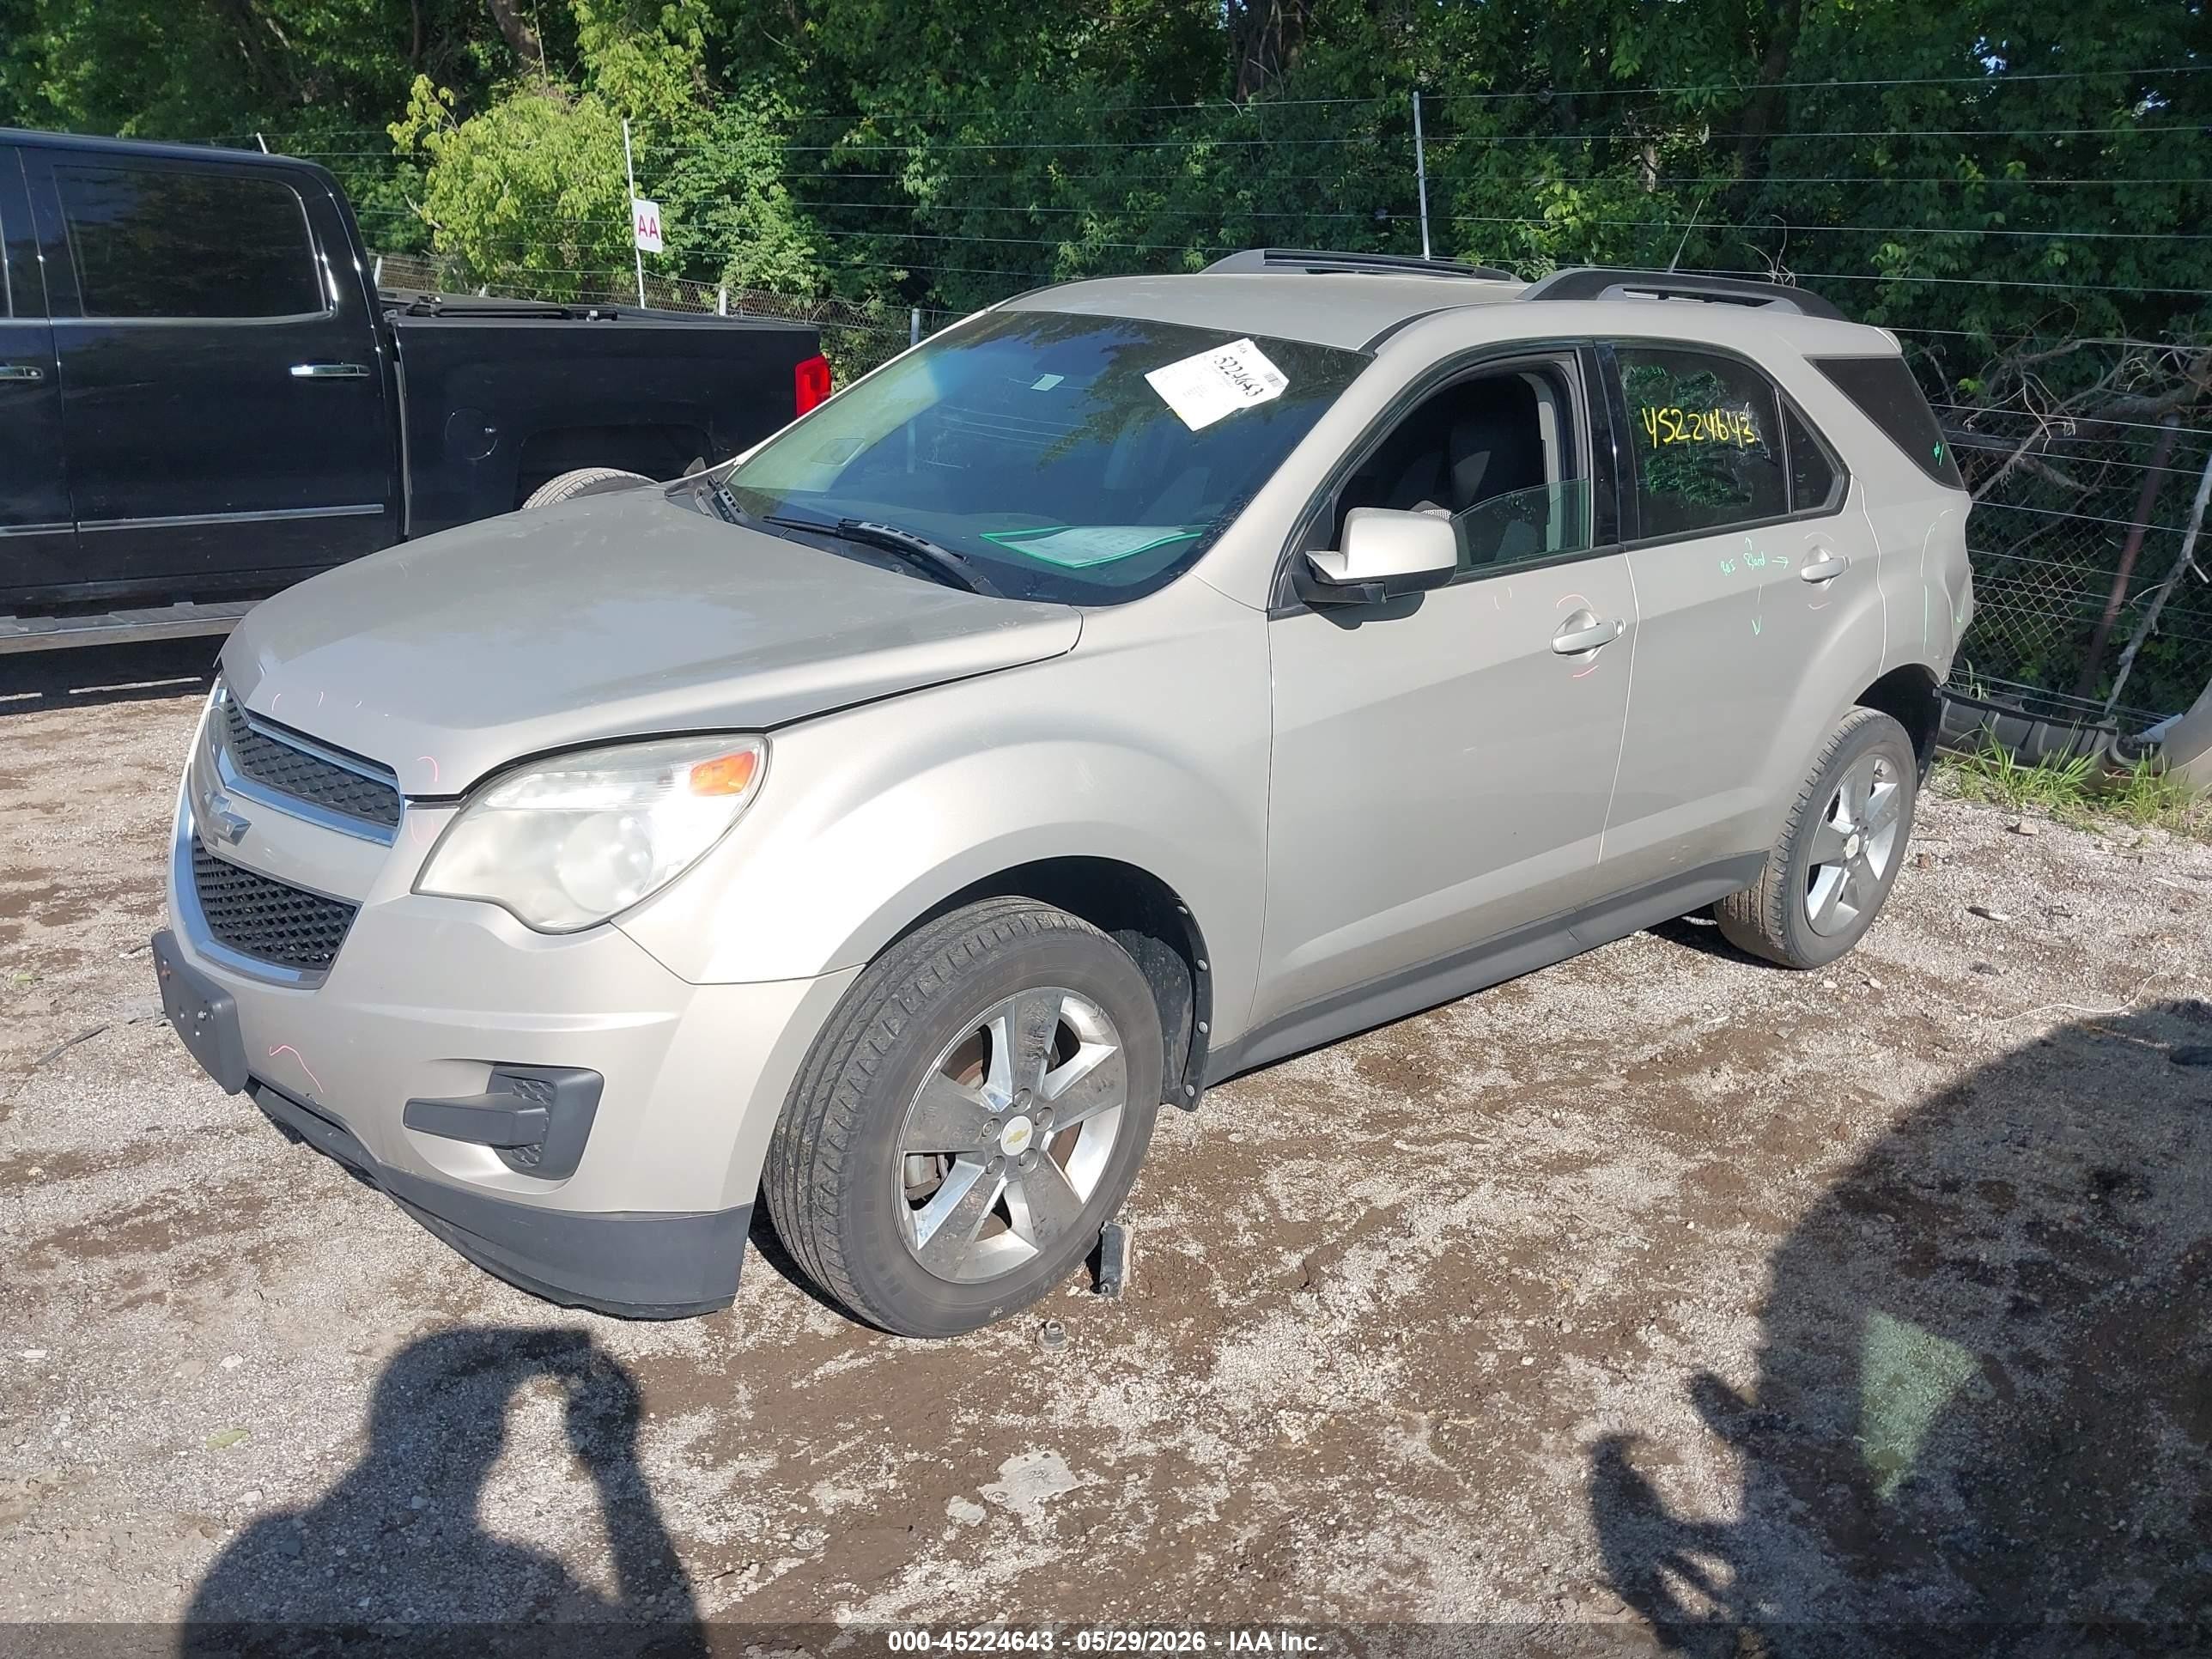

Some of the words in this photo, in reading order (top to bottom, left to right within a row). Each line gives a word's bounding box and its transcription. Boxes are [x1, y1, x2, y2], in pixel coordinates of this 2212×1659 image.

[638, 214, 659, 240] AA
[1213, 354, 1264, 397] 5224643
[1642, 407, 1755, 449] 45224643
